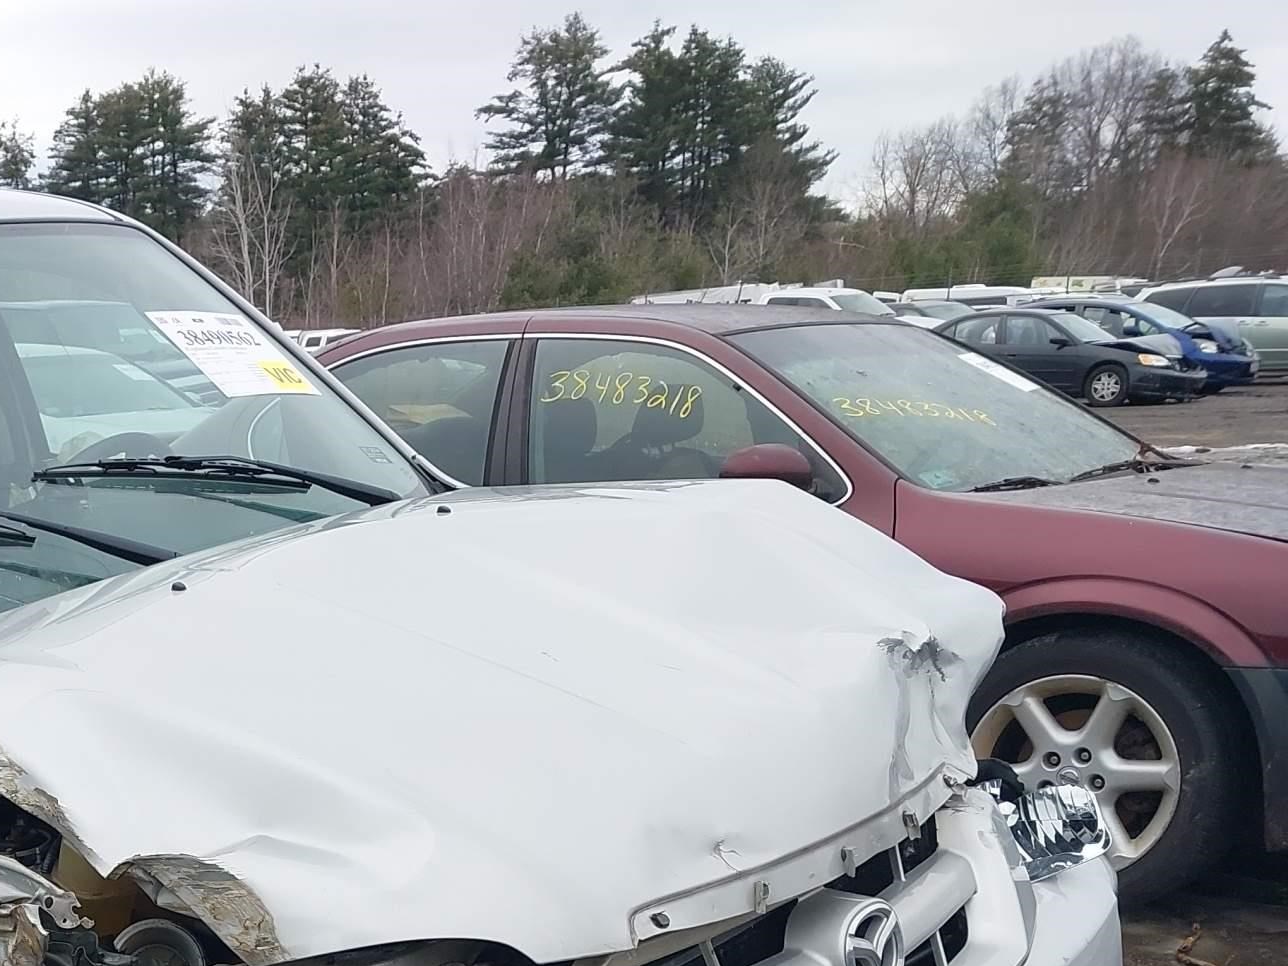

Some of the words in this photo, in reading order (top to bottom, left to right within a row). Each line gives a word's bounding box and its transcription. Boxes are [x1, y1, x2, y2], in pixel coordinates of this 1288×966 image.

[176, 329, 262, 346] 38490562
[263, 367, 303, 384] VIC
[540, 369, 703, 418] 38483218
